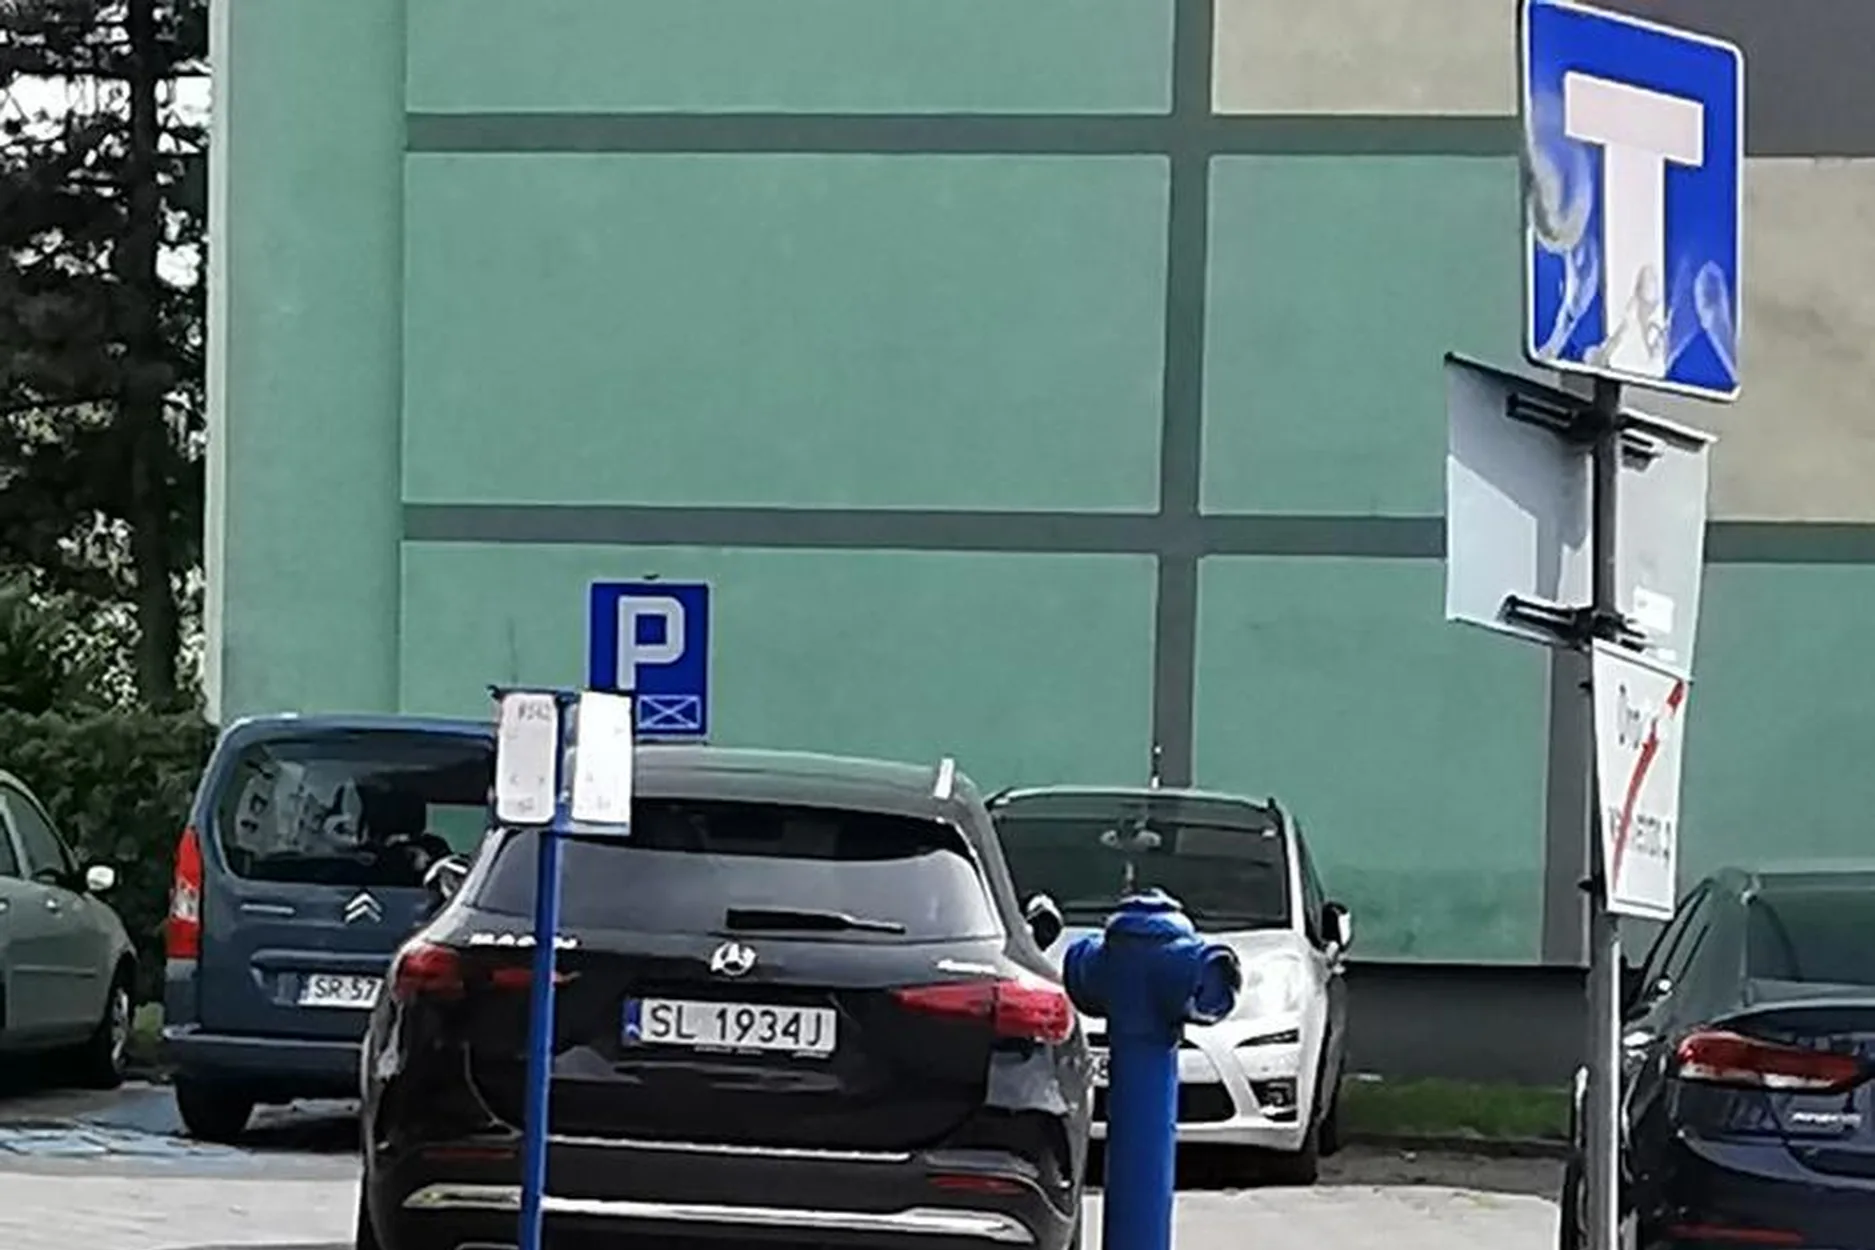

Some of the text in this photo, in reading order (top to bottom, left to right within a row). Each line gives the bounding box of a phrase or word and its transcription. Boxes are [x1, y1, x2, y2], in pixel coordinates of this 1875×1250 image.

[617, 595, 685, 690] P
[314, 978, 342, 999] SR
[650, 1003, 823, 1047] SL 1934J
